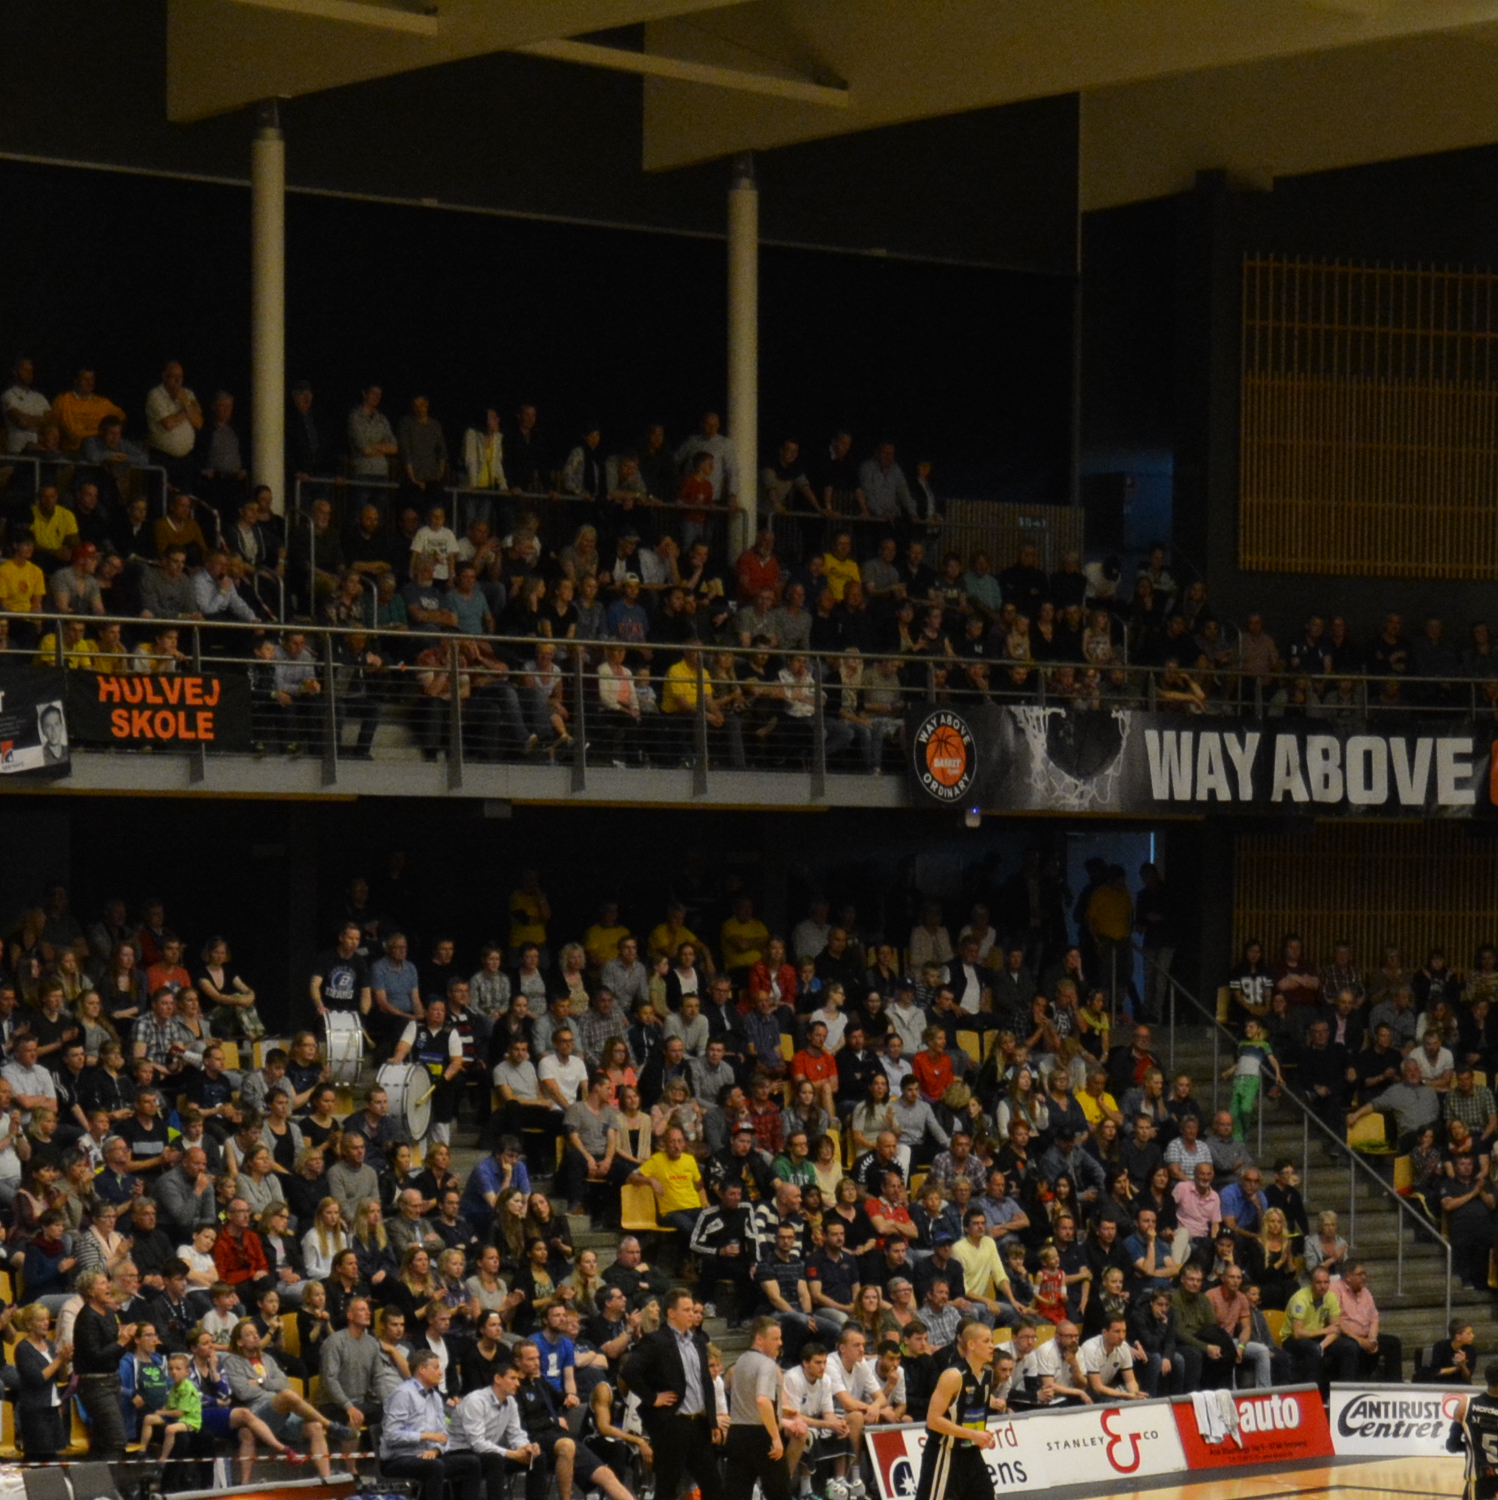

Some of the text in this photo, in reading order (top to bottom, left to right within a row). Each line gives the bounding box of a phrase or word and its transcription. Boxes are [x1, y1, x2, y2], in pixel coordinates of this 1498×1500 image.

[97, 675, 221, 707] HULVEJ
[112, 708, 214, 740] SKOLE
[918, 713, 970, 745] WAY ABOVE
[1145, 729, 1260, 802] WAY
[1271, 732, 1476, 805] ABOVE
[923, 772, 969, 798] ORDINARY
[1350, 1400, 1442, 1420] ANTIRUST
[1047, 1435, 1105, 1452] STANLEY
[1143, 1430, 1159, 1441] CO
